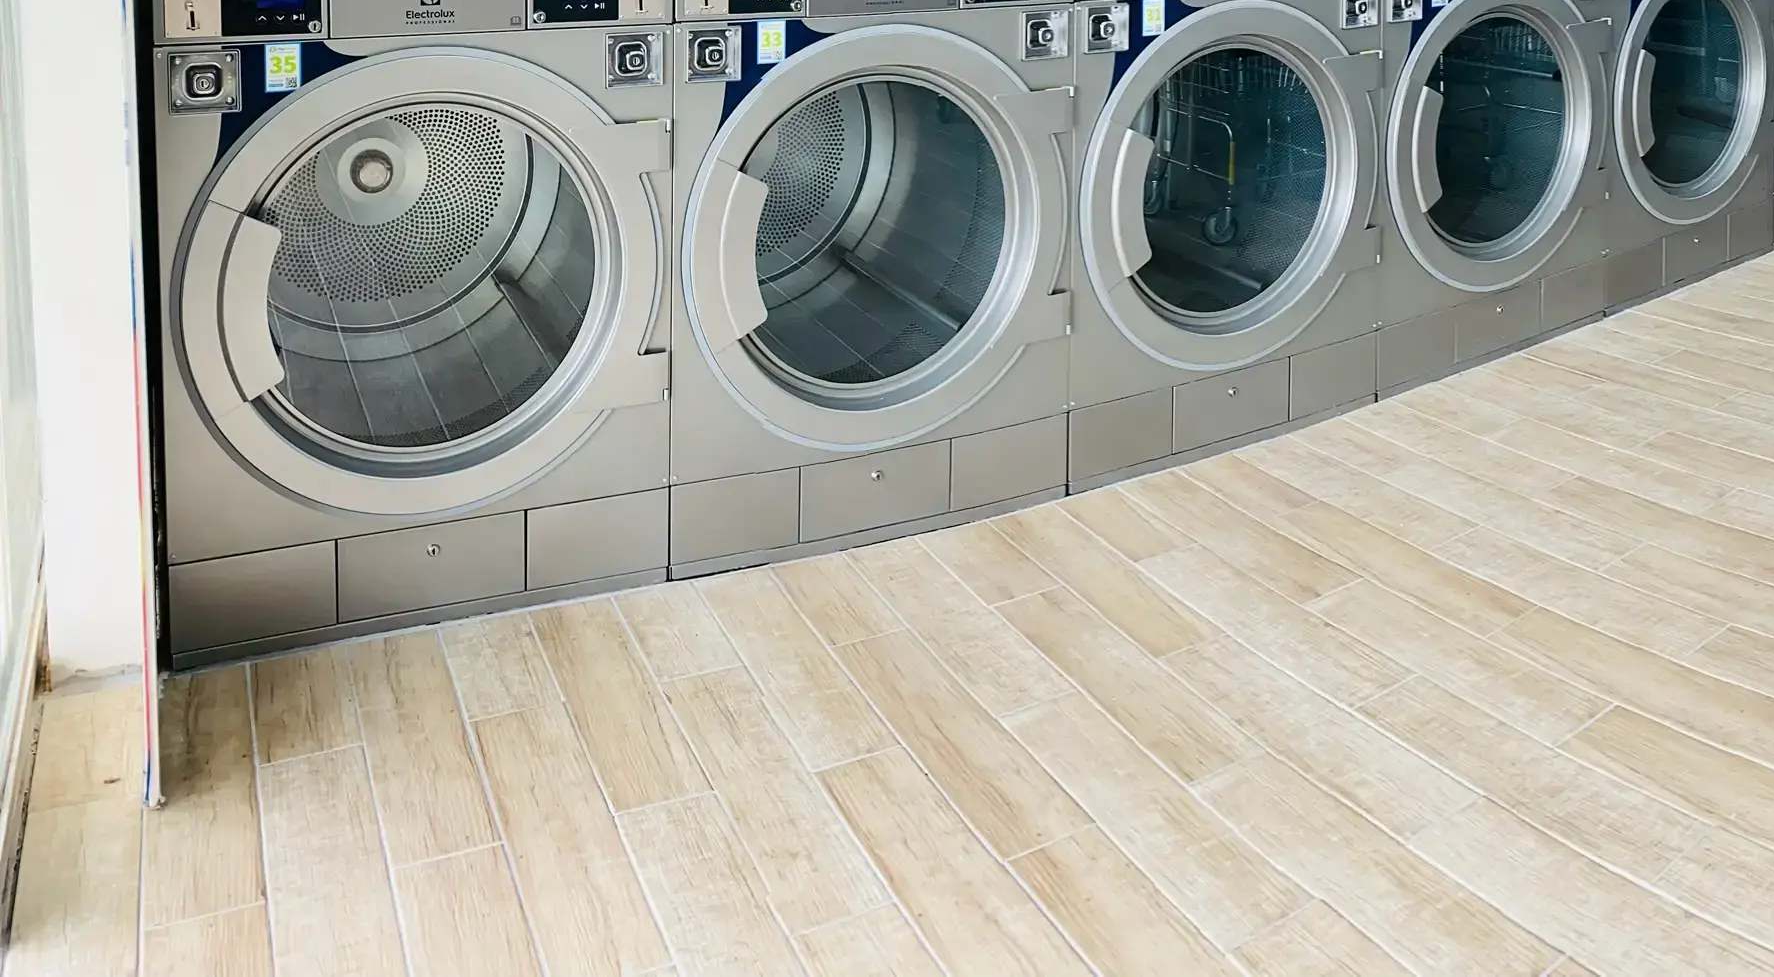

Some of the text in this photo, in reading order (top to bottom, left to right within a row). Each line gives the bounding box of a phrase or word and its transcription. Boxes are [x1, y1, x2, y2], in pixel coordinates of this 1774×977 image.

[405, 9, 455, 19] Electrolux
[760, 32, 783, 48] 33
[269, 55, 297, 75] 35
